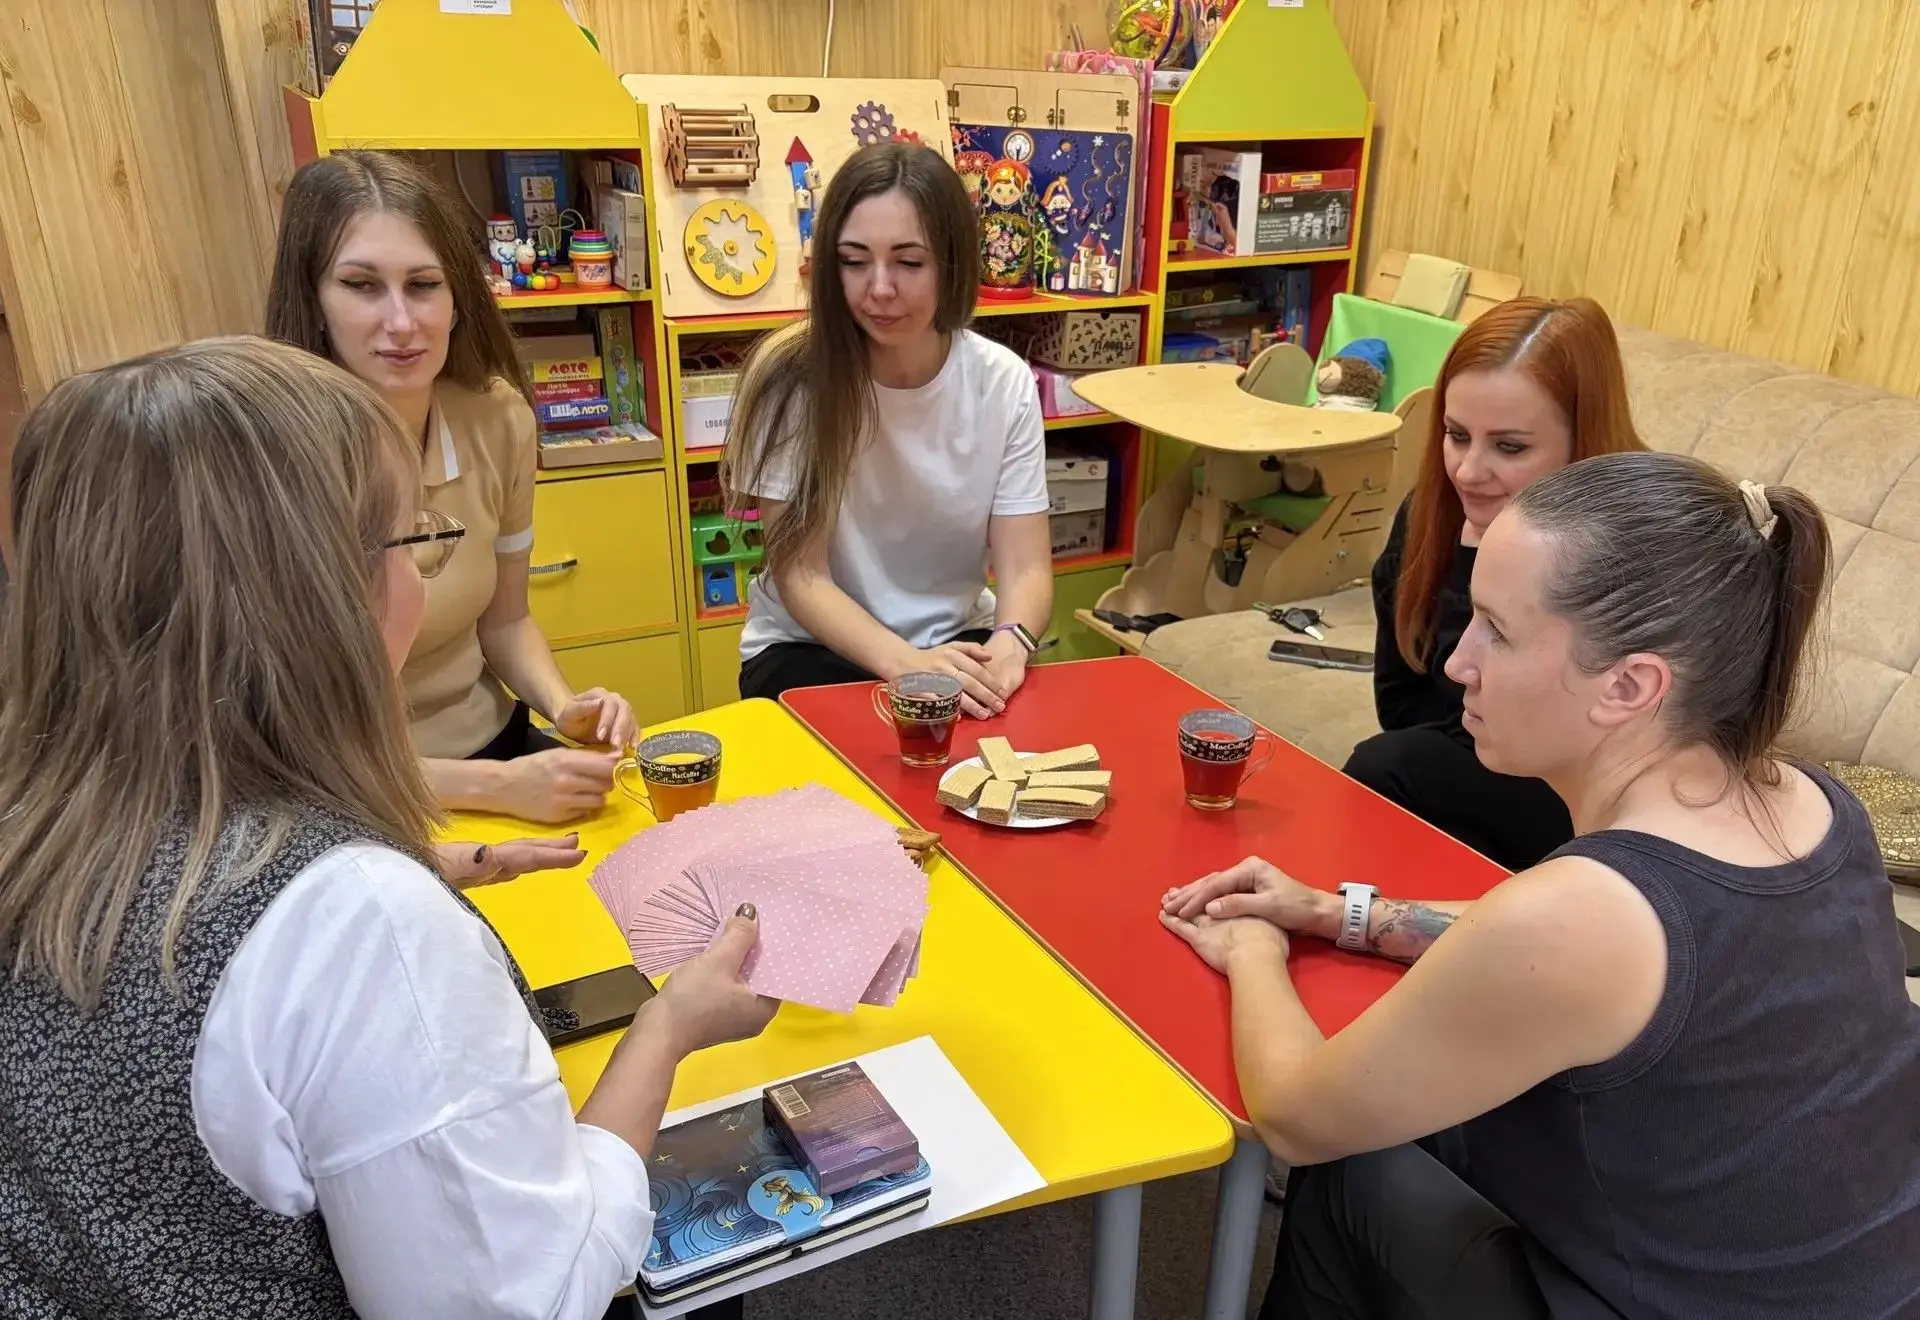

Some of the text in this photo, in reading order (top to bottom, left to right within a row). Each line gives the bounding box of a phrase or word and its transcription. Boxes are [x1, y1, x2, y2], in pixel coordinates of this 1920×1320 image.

[549, 362, 588, 375] ЛОТО
[582, 405, 609, 415] ЛОТО
[1209, 742, 1249, 750] MacCoffee
[672, 771, 700, 779] MacCoffee
